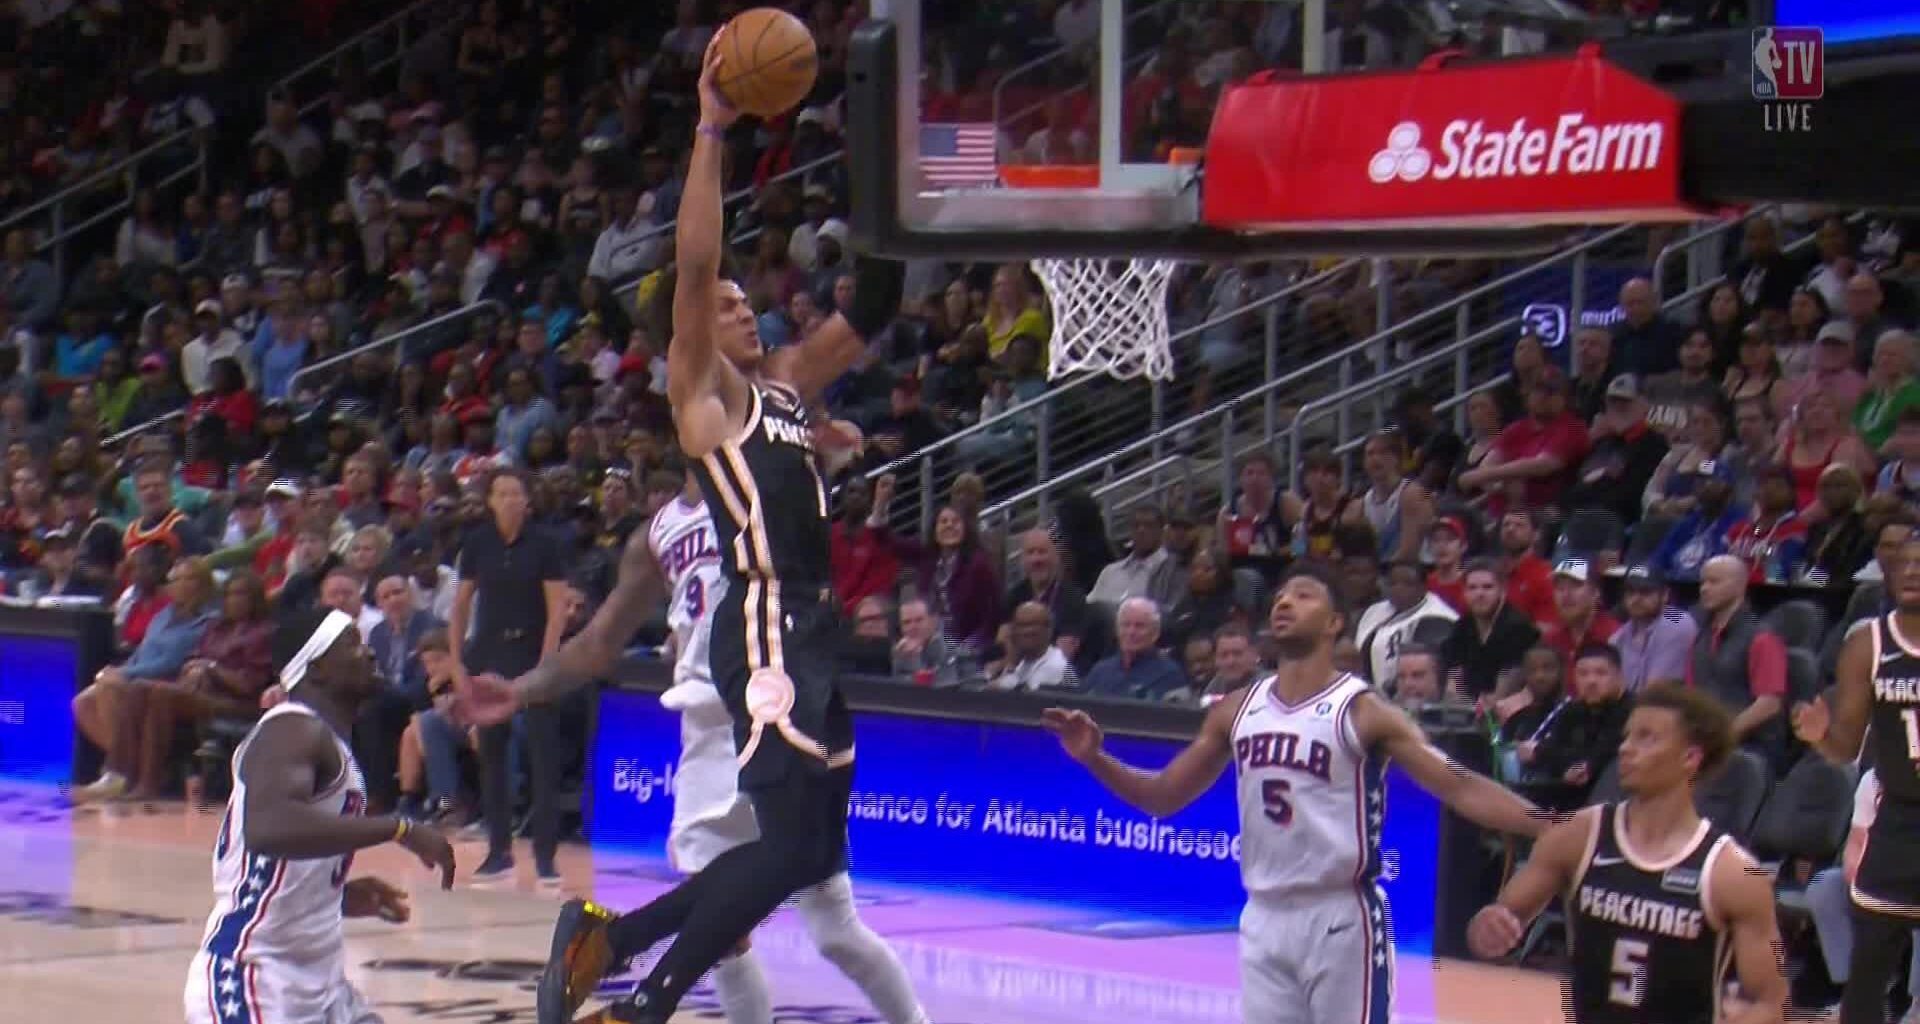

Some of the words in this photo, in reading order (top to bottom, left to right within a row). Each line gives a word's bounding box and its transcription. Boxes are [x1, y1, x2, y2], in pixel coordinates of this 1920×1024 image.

[660, 526, 718, 581] PHIL
[686, 575, 705, 620] 9
[1874, 677, 1920, 702] PEAC
[1236, 732, 1332, 783] PHILA
[613, 757, 674, 804] Big-l
[847, 790, 929, 824] nance
[935, 791, 976, 829] for
[982, 799, 1087, 844] Atlanta
[1095, 808, 1242, 862] businesse
[1262, 779, 1293, 828] 5
[1608, 938, 1649, 1006] 5
